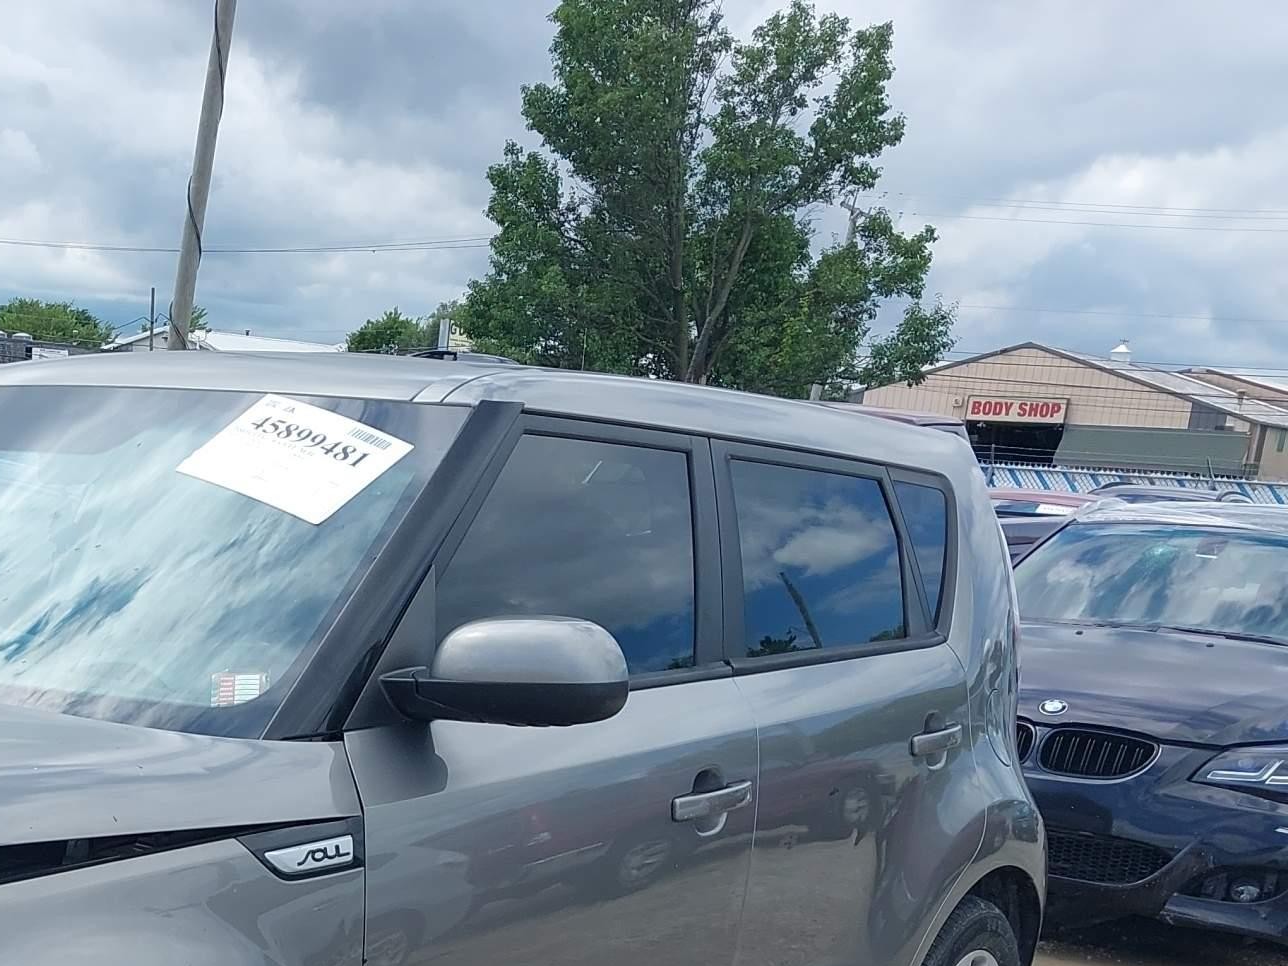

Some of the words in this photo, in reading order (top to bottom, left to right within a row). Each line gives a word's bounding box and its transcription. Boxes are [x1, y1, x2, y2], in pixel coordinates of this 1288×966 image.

[971, 400, 1014, 417] BODY
[1017, 401, 1062, 418] SHOP
[251, 415, 372, 468] 45899481
[296, 844, 351, 867] SOUL
